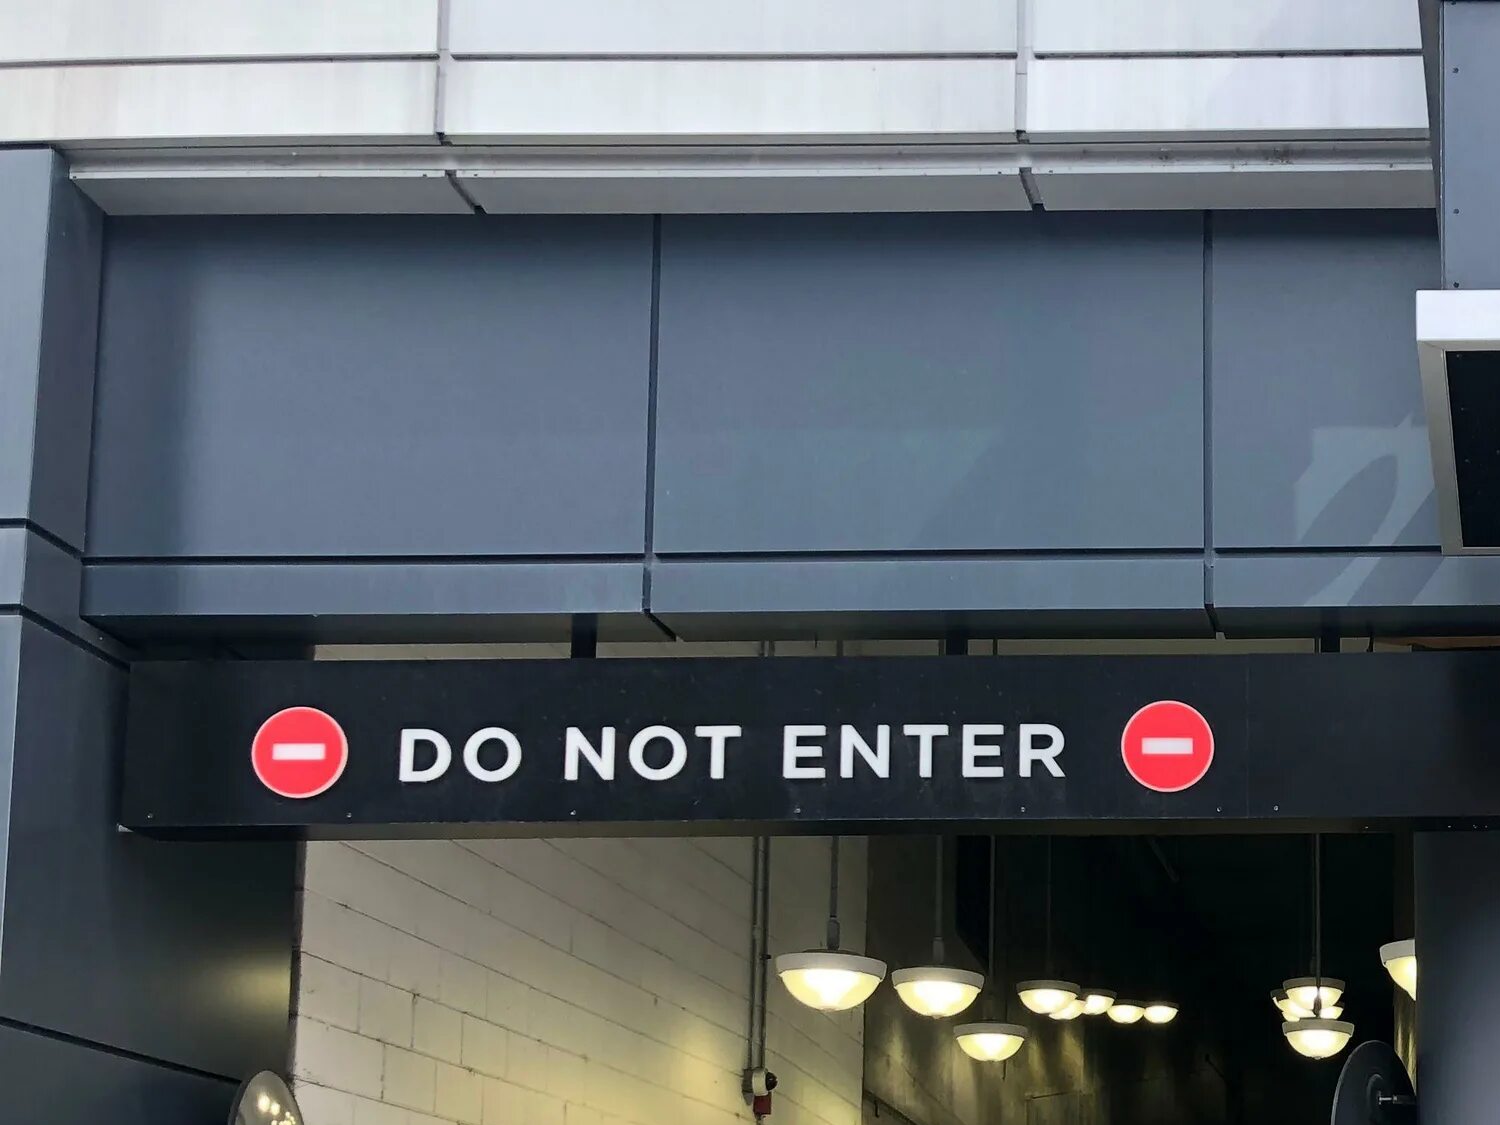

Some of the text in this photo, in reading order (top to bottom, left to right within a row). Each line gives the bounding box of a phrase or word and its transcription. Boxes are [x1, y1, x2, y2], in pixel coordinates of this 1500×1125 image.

[398, 723, 1066, 782] DO NOT ENTER
